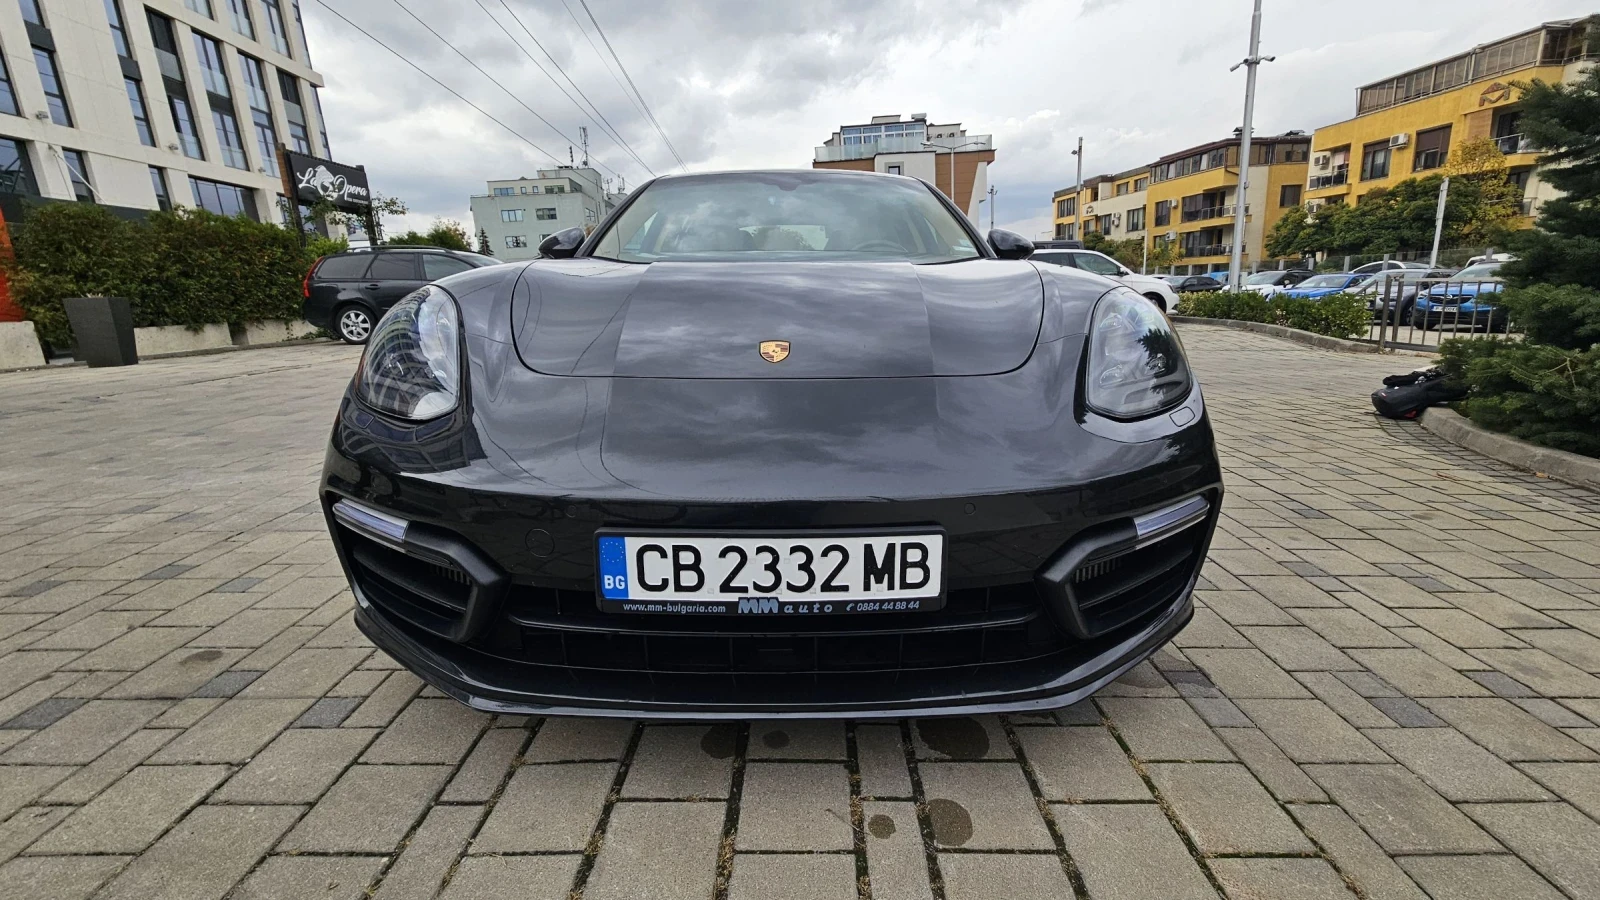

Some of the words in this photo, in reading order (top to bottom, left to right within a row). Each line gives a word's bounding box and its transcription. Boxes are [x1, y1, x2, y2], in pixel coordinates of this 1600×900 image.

[297, 168, 317, 189] La
[334, 175, 368, 201] Opera
[636, 544, 705, 592] CB
[718, 544, 850, 593] 2332
[863, 542, 931, 591] MB
[604, 575, 625, 589] BG
[623, 603, 726, 614] www.mm-bulgaria.com
[737, 597, 779, 614] MM
[784, 602, 833, 614] auto
[857, 602, 880, 612] 0884
[881, 602, 894, 610] 44
[895, 601, 907, 610] 88
[907, 600, 920, 609] 44
